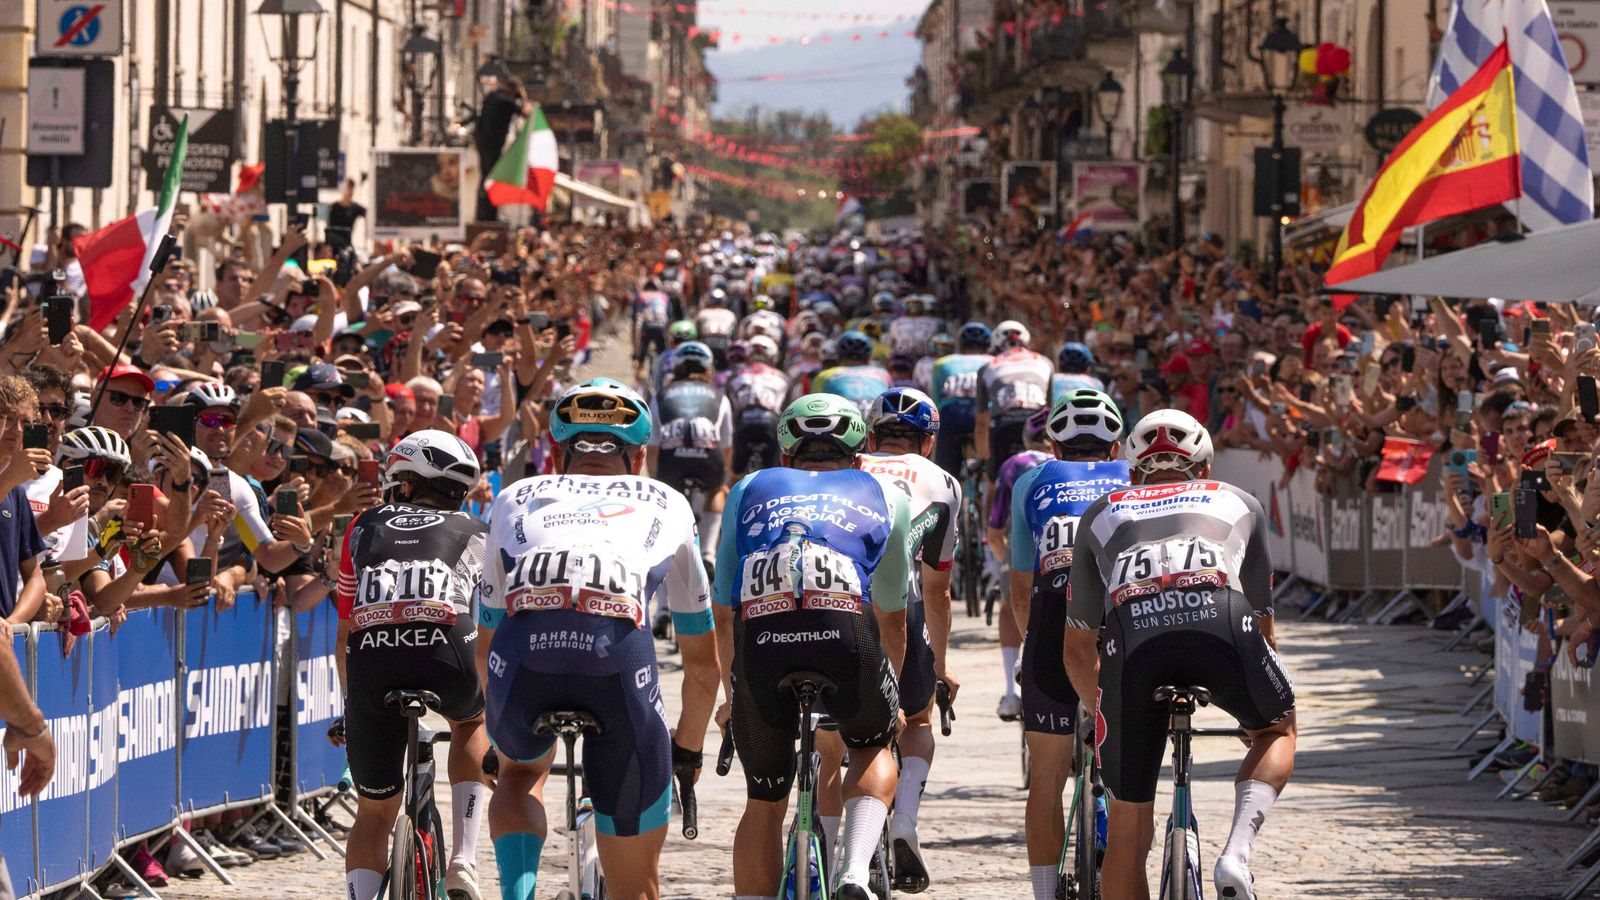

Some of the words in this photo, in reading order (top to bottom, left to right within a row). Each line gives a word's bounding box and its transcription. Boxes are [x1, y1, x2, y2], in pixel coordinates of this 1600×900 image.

[515, 475, 668, 501] BAHRAIN
[874, 468, 918, 484] Bull
[1056, 487, 1097, 498] AG2R
[1111, 495, 1212, 514] deceuninck
[543, 511, 591, 522] Bapco
[766, 493, 886, 524] DECATHLON
[822, 502, 847, 520] LA
[543, 518, 609, 529] energies
[643, 516, 663, 552] MERIDA
[768, 512, 858, 534] MODIALE
[908, 511, 939, 549] ansgrohe
[1046, 521, 1075, 552] 91
[1118, 549, 1151, 584] 75
[1179, 541, 1217, 570] 75
[508, 550, 570, 591] 101
[750, 552, 783, 597] 94
[1130, 590, 1216, 618] BRUSTOR
[1133, 617, 1159, 630] SUN
[1164, 608, 1218, 626] SYSTEMS
[360, 628, 449, 650] ARKEA
[530, 630, 595, 643] BAHRAIN
[530, 640, 593, 651] VICTORIOUS
[772, 629, 841, 643] DECATHLON
[297, 654, 344, 725] SHIMA
[1264, 662, 1284, 694] WINDOWS
[185, 660, 272, 739] SHIMANO
[118, 678, 177, 764] SHIMAN
